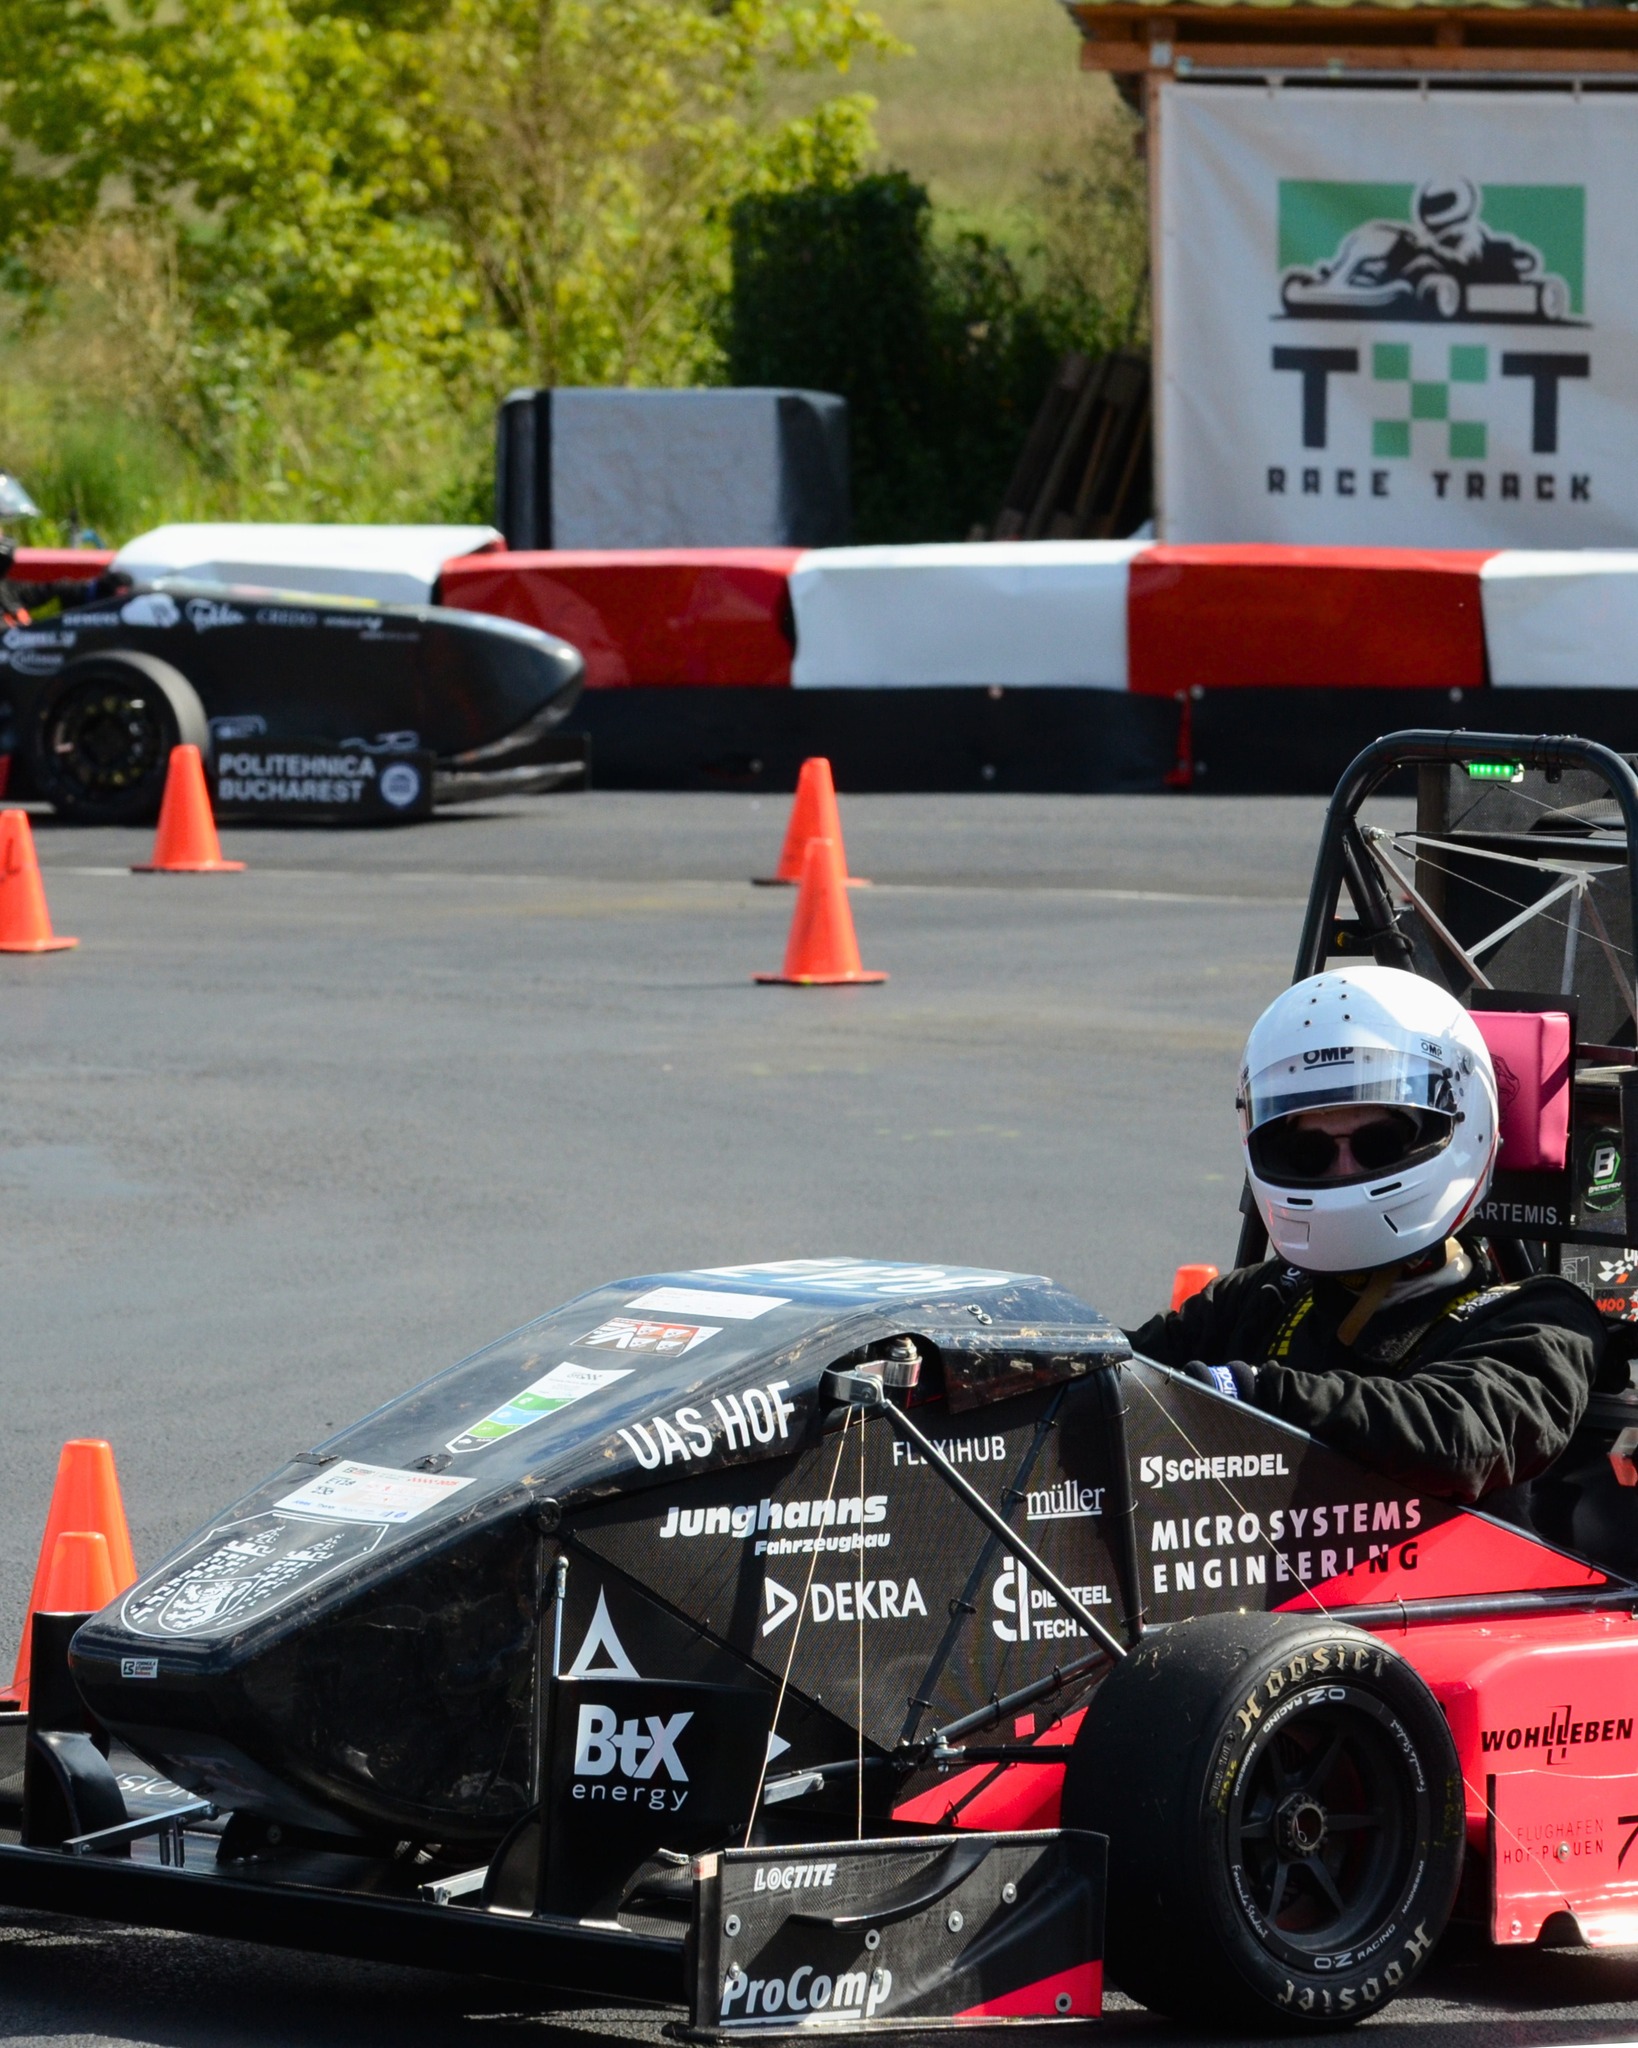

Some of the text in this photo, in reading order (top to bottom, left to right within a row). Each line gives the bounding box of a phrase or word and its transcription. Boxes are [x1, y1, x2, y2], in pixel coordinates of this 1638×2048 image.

[1267, 467, 1592, 501] RACE TRACK
[218, 753, 376, 778] POLITEHNICA
[218, 778, 364, 801] BUCHAREST
[1303, 1046, 1354, 1064] OMP
[1420, 1041, 1443, 1056] OMP
[617, 1380, 796, 1470] UAS HOF
[892, 1436, 1006, 1466] FLXIHUB
[1165, 1453, 1290, 1482] SCHERDEL
[1026, 1480, 1106, 1515] müller
[660, 1495, 889, 1539] Junghanns
[754, 1532, 891, 1556] Fahrzeugbau
[1153, 1541, 1419, 1594] ENGINEERING
[811, 1577, 928, 1623] DEKRA
[1262, 1696, 1303, 1734] RACING
[574, 1703, 694, 1782] BtX
[1481, 1707, 1634, 1763] WOHLLEBEN
[572, 1783, 689, 1811] energy
[1517, 1819, 1604, 1842] FLUGHAFEN
[1503, 1839, 1604, 1865] HOF-PLUEN
[754, 1863, 837, 1892] LOCTITE
[1357, 1923, 1397, 1961] RACING
[720, 1965, 893, 2019] ProComp
